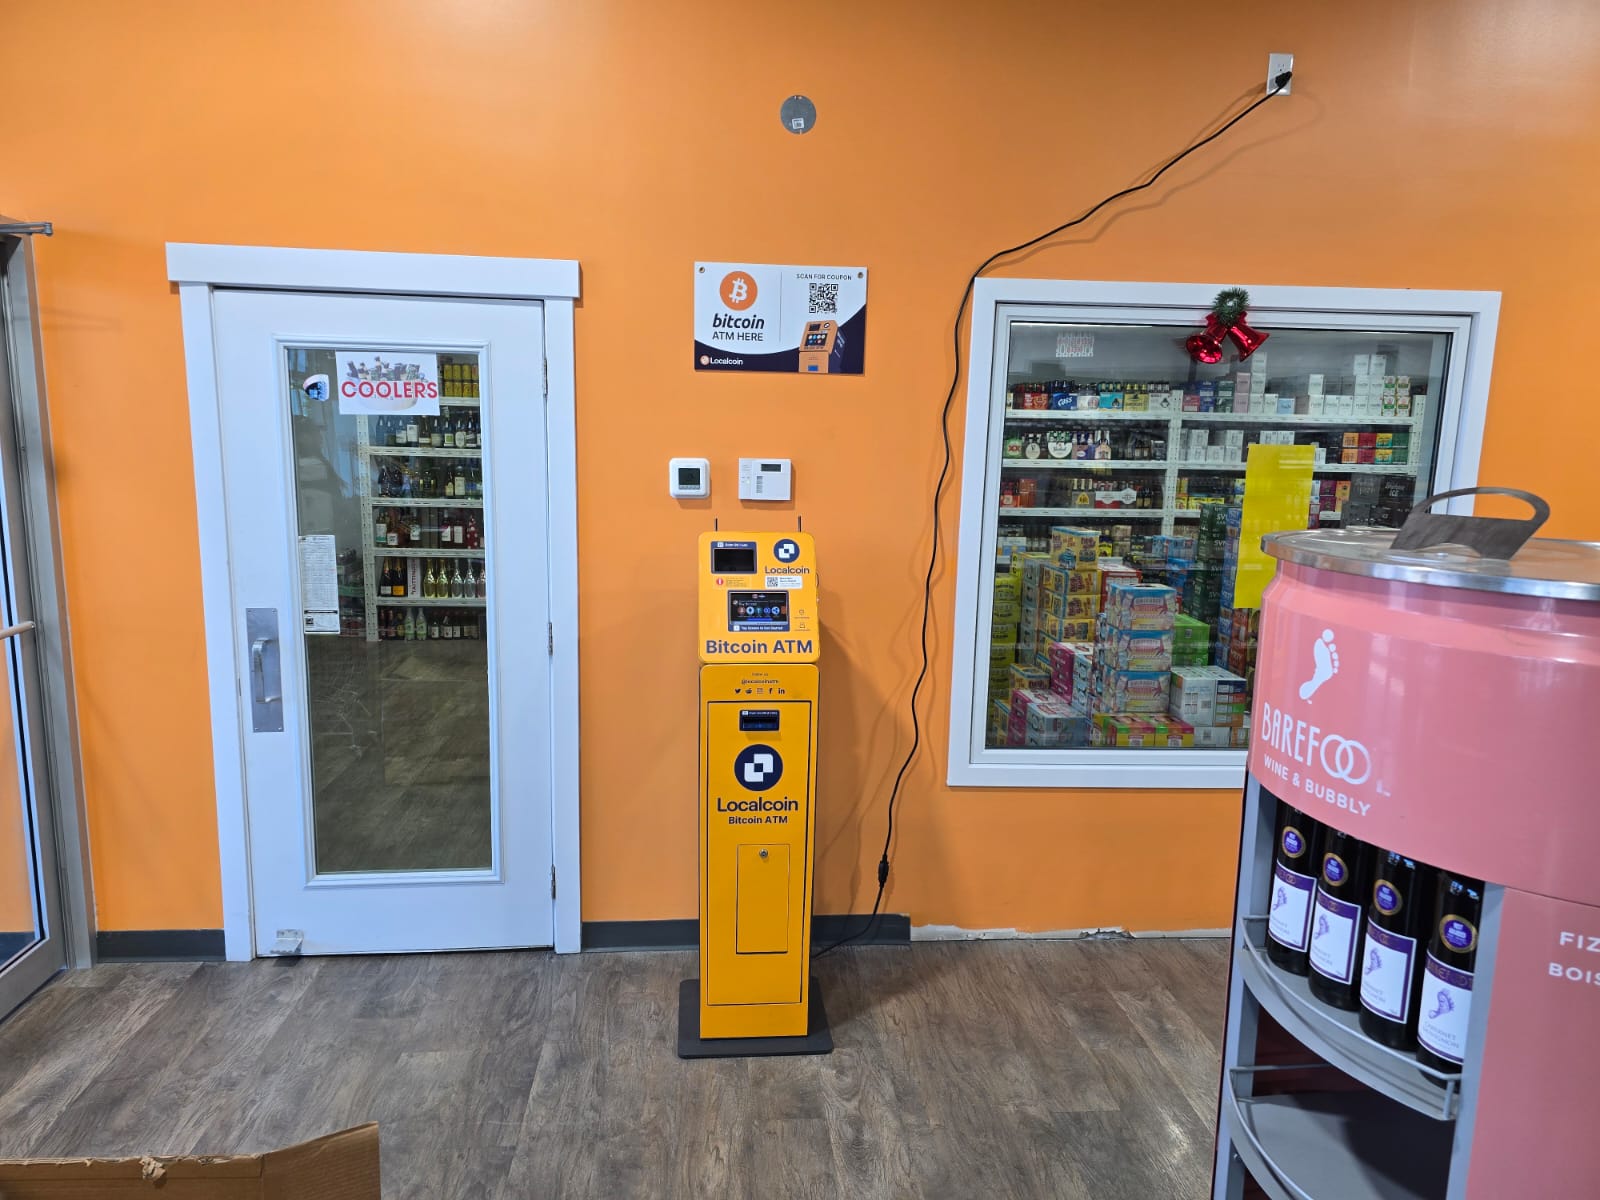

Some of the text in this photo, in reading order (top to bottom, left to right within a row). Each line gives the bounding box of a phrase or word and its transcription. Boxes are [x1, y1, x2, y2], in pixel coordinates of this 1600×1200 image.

[712, 313, 765, 330] bitcoin
[712, 331, 764, 342] ATM HERE
[710, 356, 743, 366] Localcoin
[341, 381, 438, 398] COOLERS
[765, 565, 810, 575] Localcoin
[706, 639, 813, 654] Bitcoin ATM
[1264, 753, 1371, 816] WINE & BUBBLY
[717, 796, 799, 812] Localcoin
[728, 816, 788, 825] Bitcoin ATM
